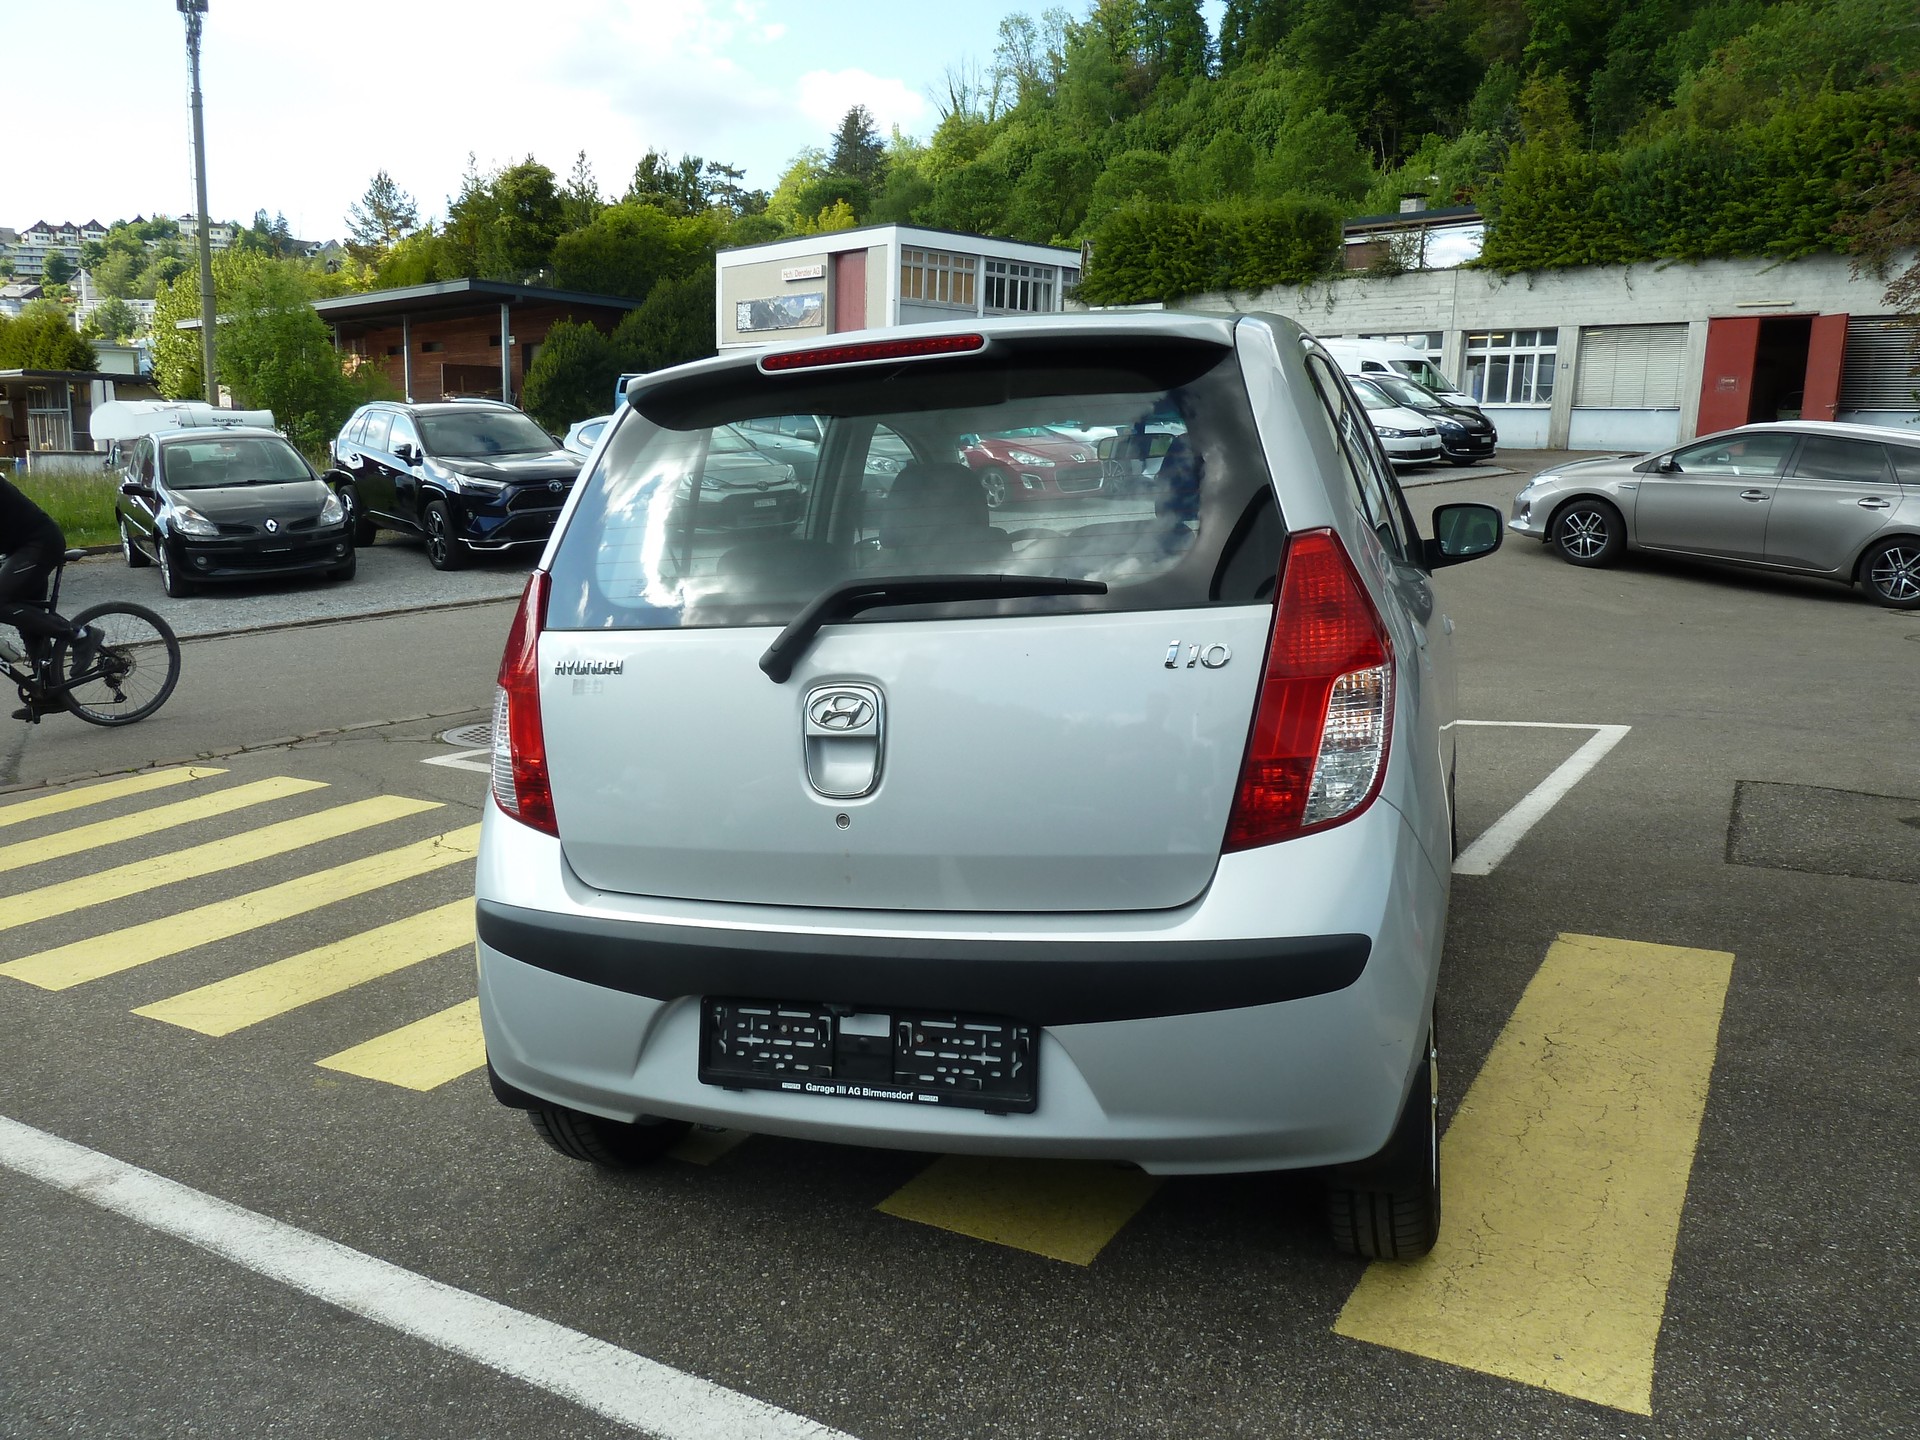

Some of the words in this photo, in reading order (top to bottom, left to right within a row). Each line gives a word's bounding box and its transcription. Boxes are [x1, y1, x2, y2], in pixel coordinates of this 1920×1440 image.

[555, 659, 624, 676] HYUNDAI
[805, 1082, 835, 1095] Garage
[848, 1086, 860, 1096] AG
[862, 1087, 914, 1101] Birmensdorf
